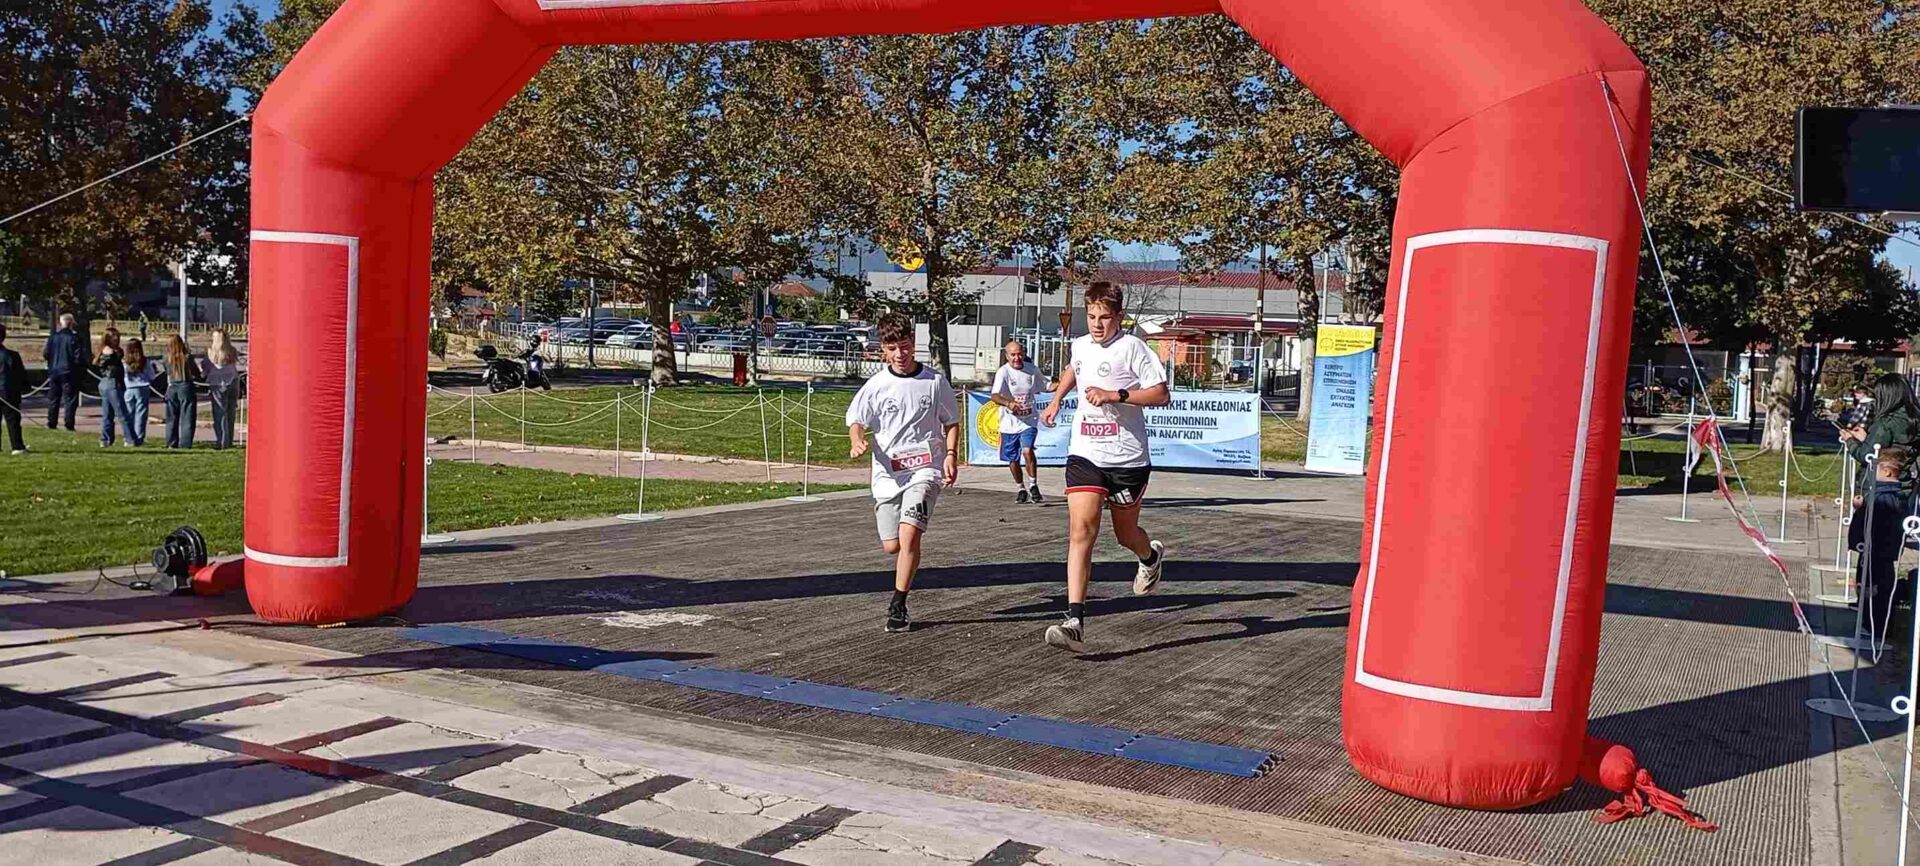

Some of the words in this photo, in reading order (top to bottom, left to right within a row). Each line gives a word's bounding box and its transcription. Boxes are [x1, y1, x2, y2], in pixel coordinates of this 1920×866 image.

[1190, 400, 1252, 412] ΜΑΚΕΔΟΝΙΑΣ
[1151, 415, 1218, 426] ΕΠΙΚΟΙΝΩΝΙΩΝ
[1085, 424, 1112, 436] 1092
[1159, 429, 1204, 440] ΑΝΑΓΚΩΝ
[900, 456, 923, 469] 600
